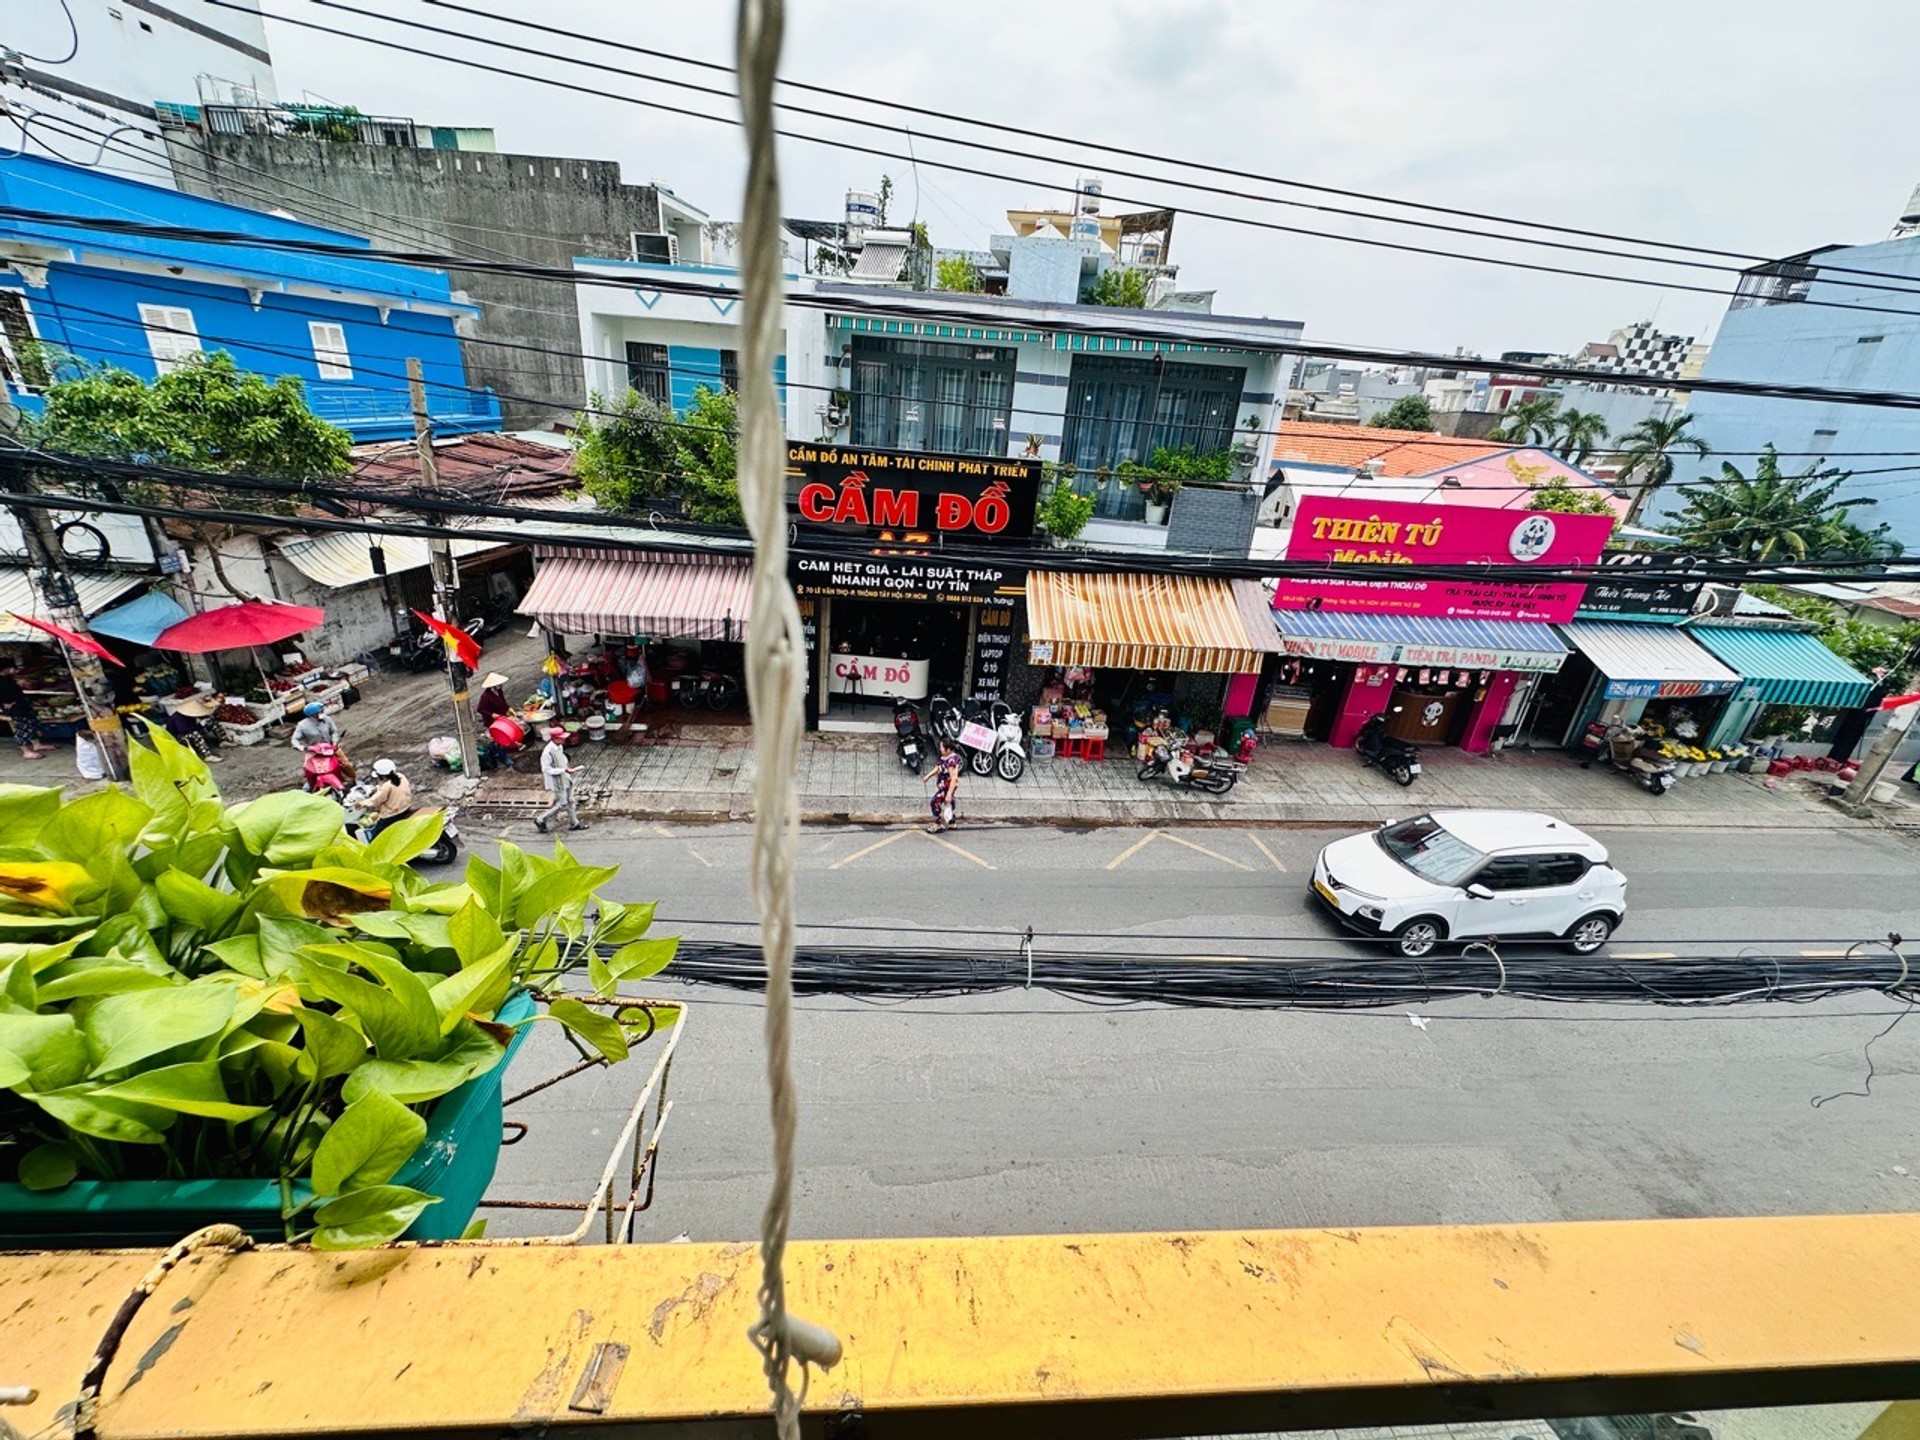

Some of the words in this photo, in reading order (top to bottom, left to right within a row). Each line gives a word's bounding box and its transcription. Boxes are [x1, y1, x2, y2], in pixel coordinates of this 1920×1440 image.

[841, 453, 858, 465] AN
[861, 453, 888, 467] TÂM
[798, 471, 919, 528] CẦM
[936, 481, 1011, 533] ĐỒ
[1312, 515, 1401, 544] THIÊN
[1405, 518, 1444, 546] TÚ
[832, 574, 880, 587] NHANH
[884, 577, 914, 591] GỌN
[926, 579, 945, 590] UY
[948, 579, 970, 592] TÍN
[981, 649, 1003, 658] LAPTOP
[1338, 643, 1378, 660] MOBILE
[1459, 652, 1499, 666] PANDA
[835, 657, 878, 681] CẦM
[884, 662, 911, 683] ĐỒ
